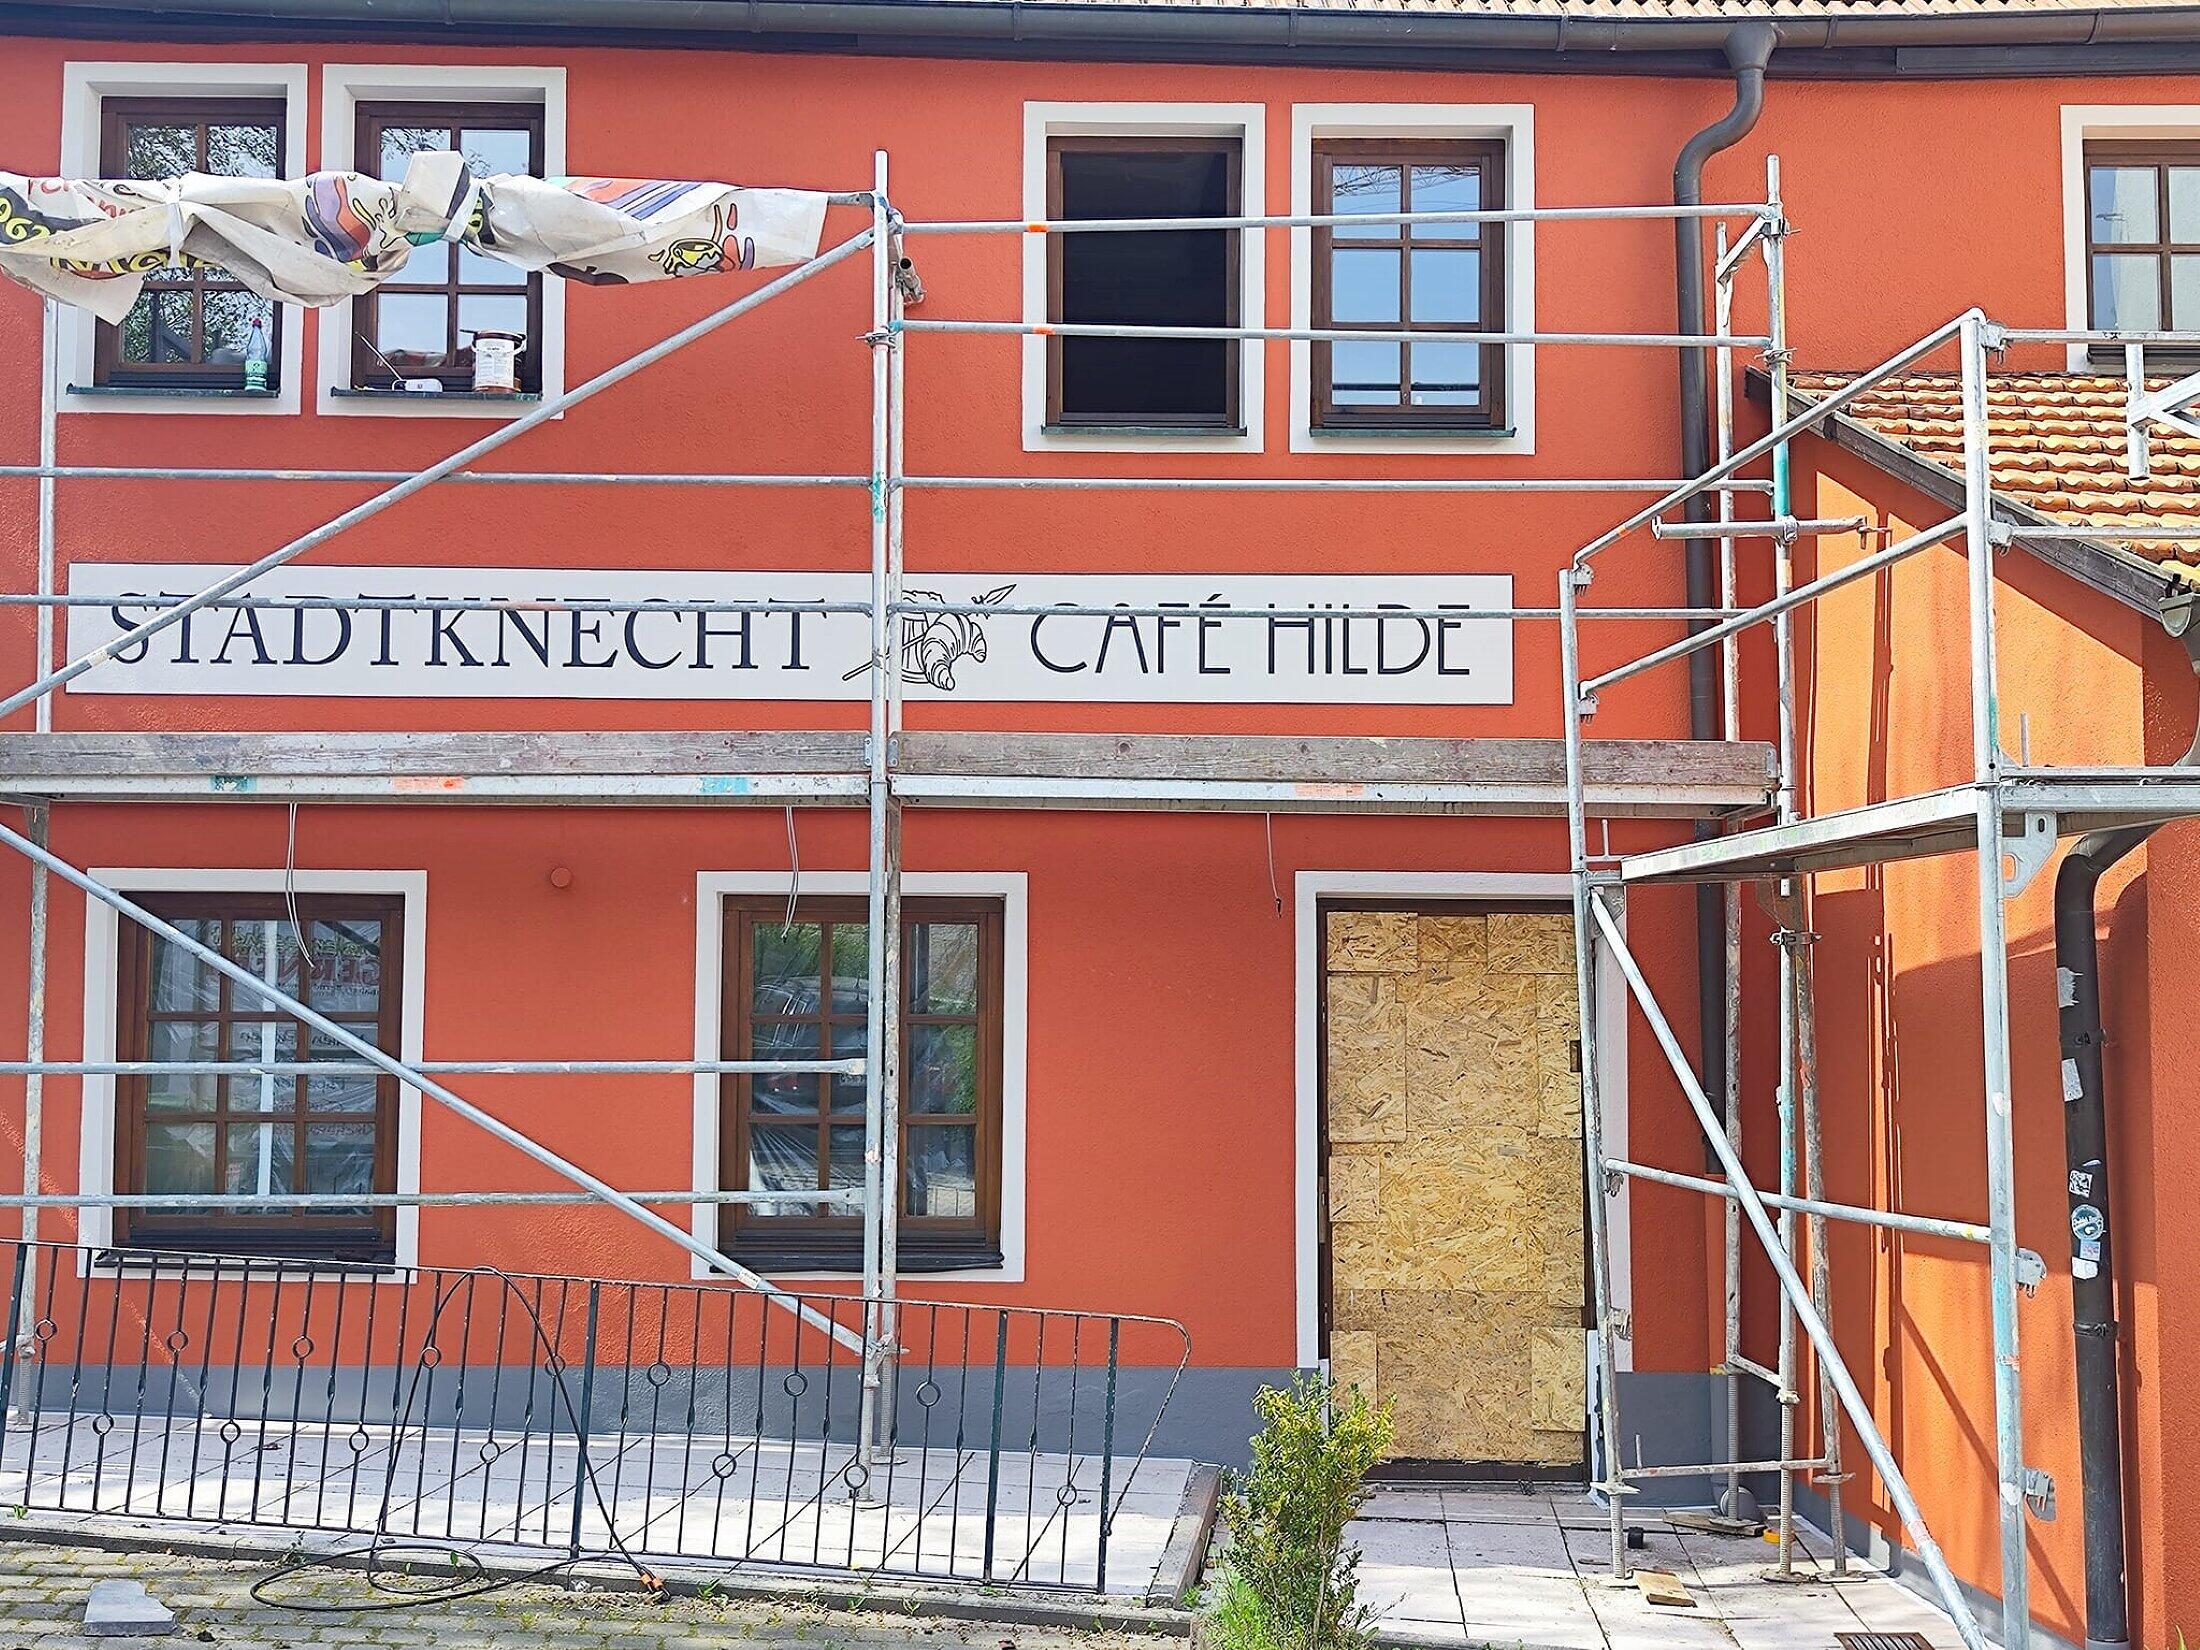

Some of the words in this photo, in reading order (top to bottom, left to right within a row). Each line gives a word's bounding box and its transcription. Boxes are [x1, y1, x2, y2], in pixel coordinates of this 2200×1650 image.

[110, 592, 827, 671] STADTKNECHT
[1030, 593, 1231, 674] CAFÉ
[1267, 603, 1470, 676] HILDE
